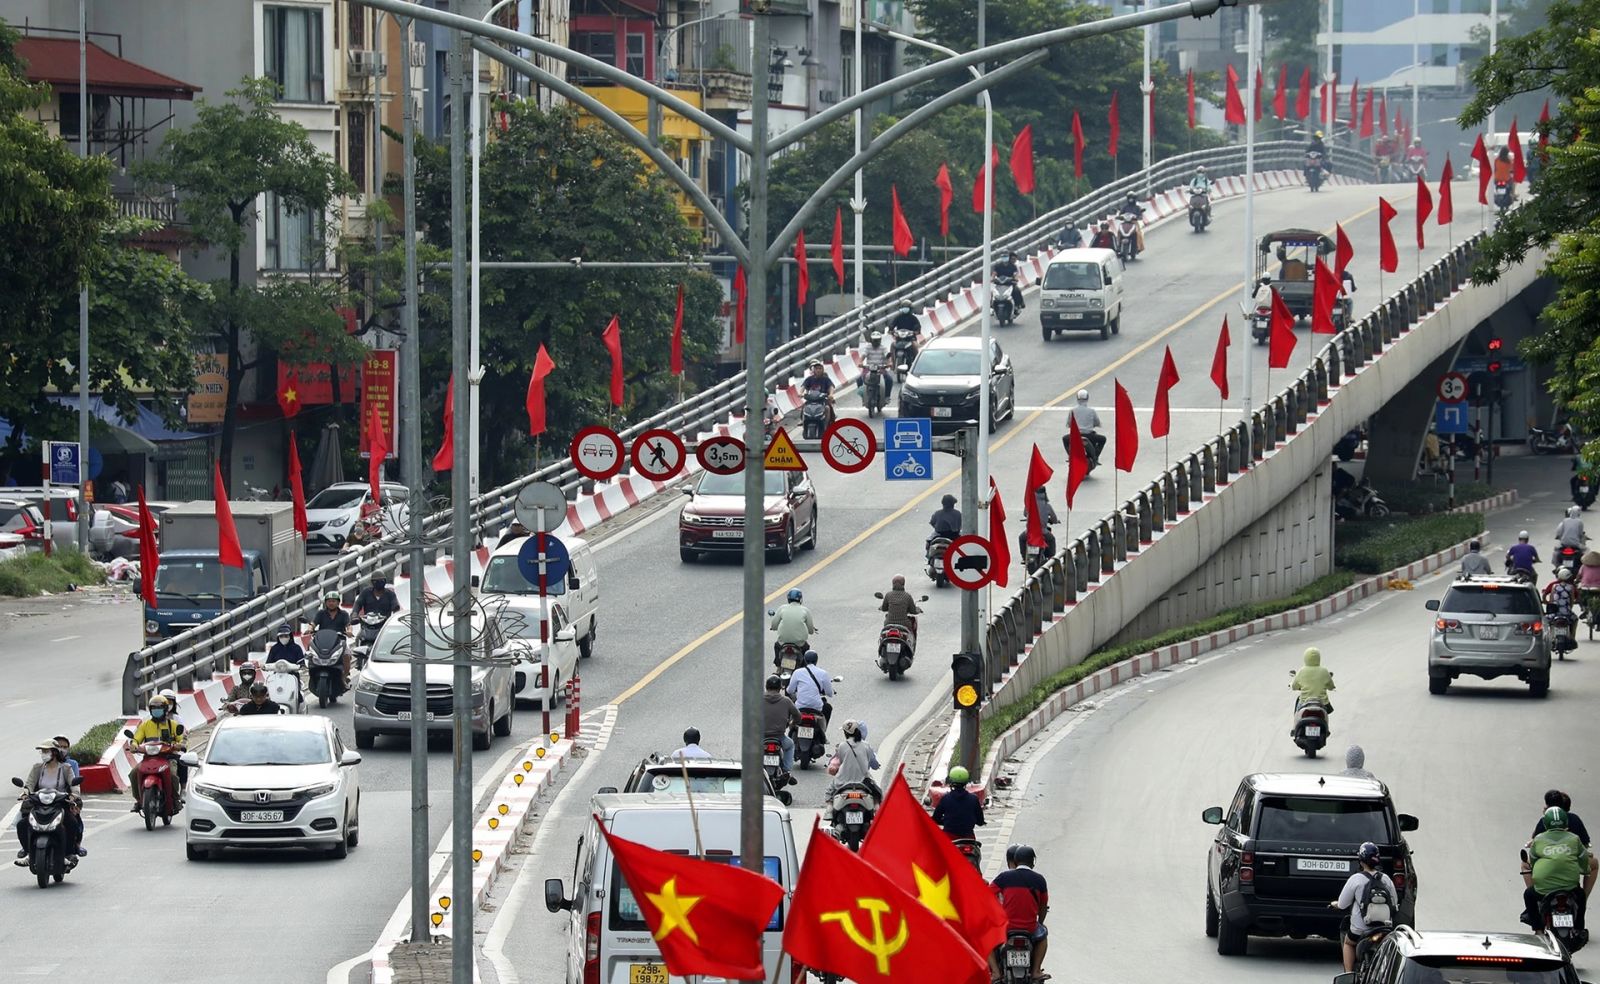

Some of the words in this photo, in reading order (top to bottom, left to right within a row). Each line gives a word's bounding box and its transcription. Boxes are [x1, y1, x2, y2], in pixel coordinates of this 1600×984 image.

[368, 360, 389, 369] 19-8
[710, 447, 739, 463] 3,5m
[769, 456, 793, 465] CHẬM
[640, 966, 659, 975] 29B
[635, 976, 665, 984] 198.72
